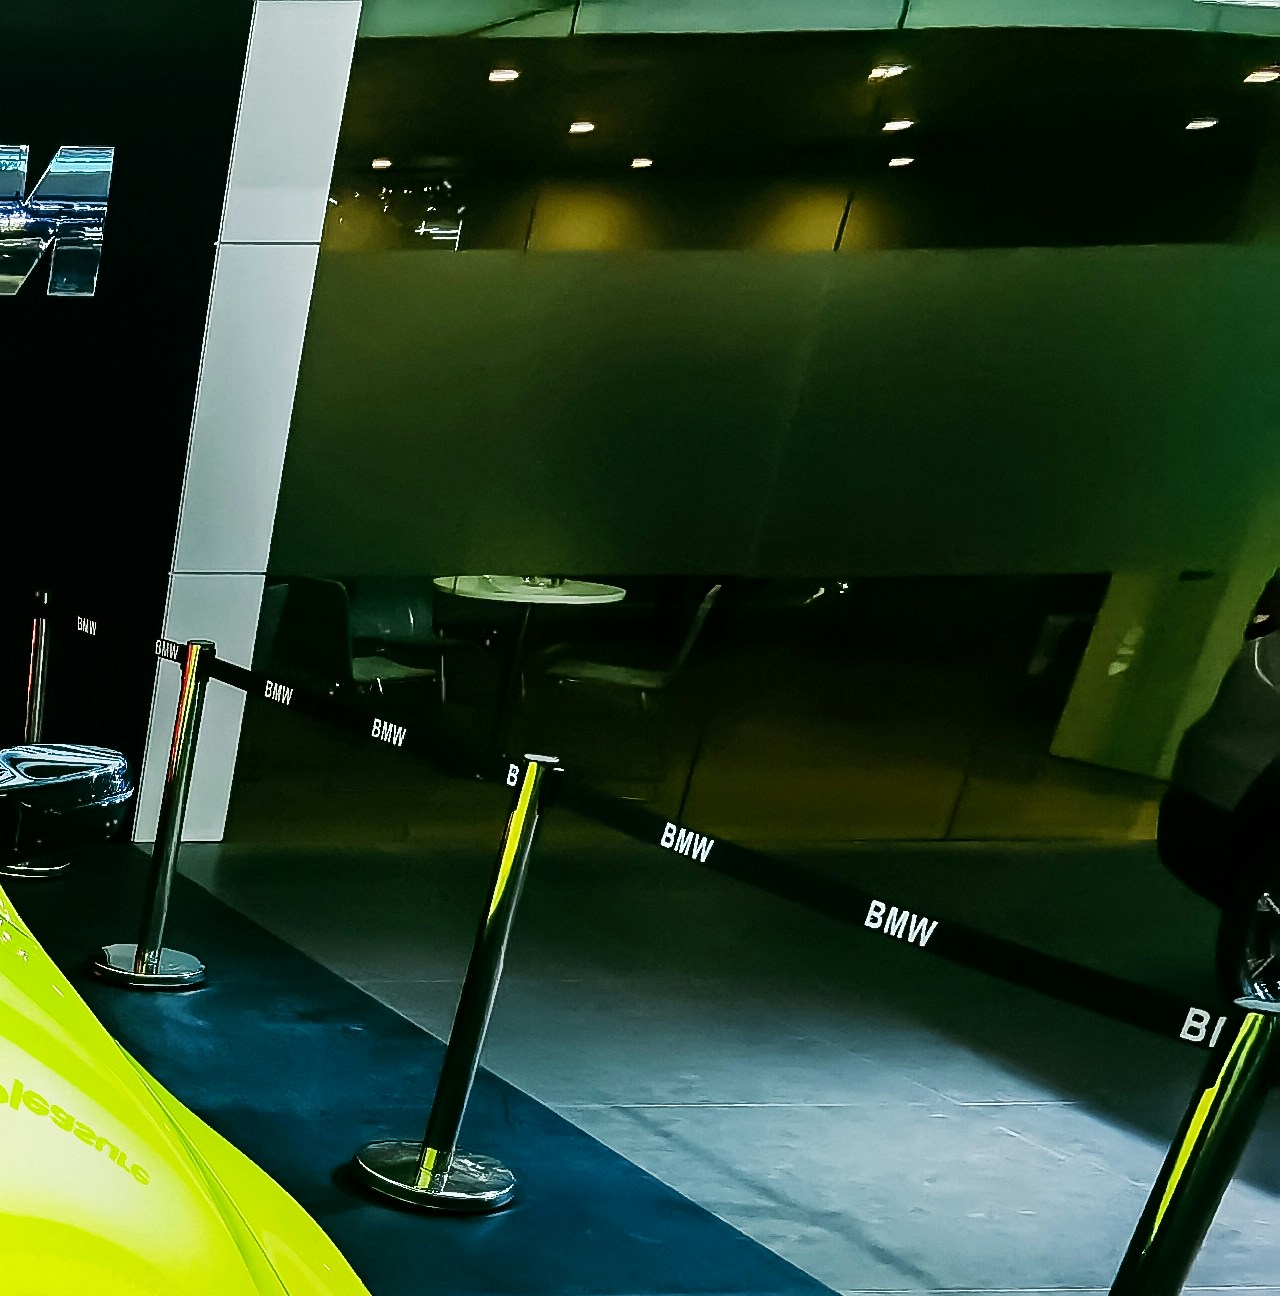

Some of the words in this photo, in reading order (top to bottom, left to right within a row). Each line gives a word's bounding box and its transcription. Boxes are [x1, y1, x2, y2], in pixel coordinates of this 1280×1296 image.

[155, 639, 180, 661] BMW
[264, 679, 294, 706] BMW
[371, 717, 407, 747] BMW
[660, 821, 715, 863] BMW
[864, 899, 939, 947] BMW
